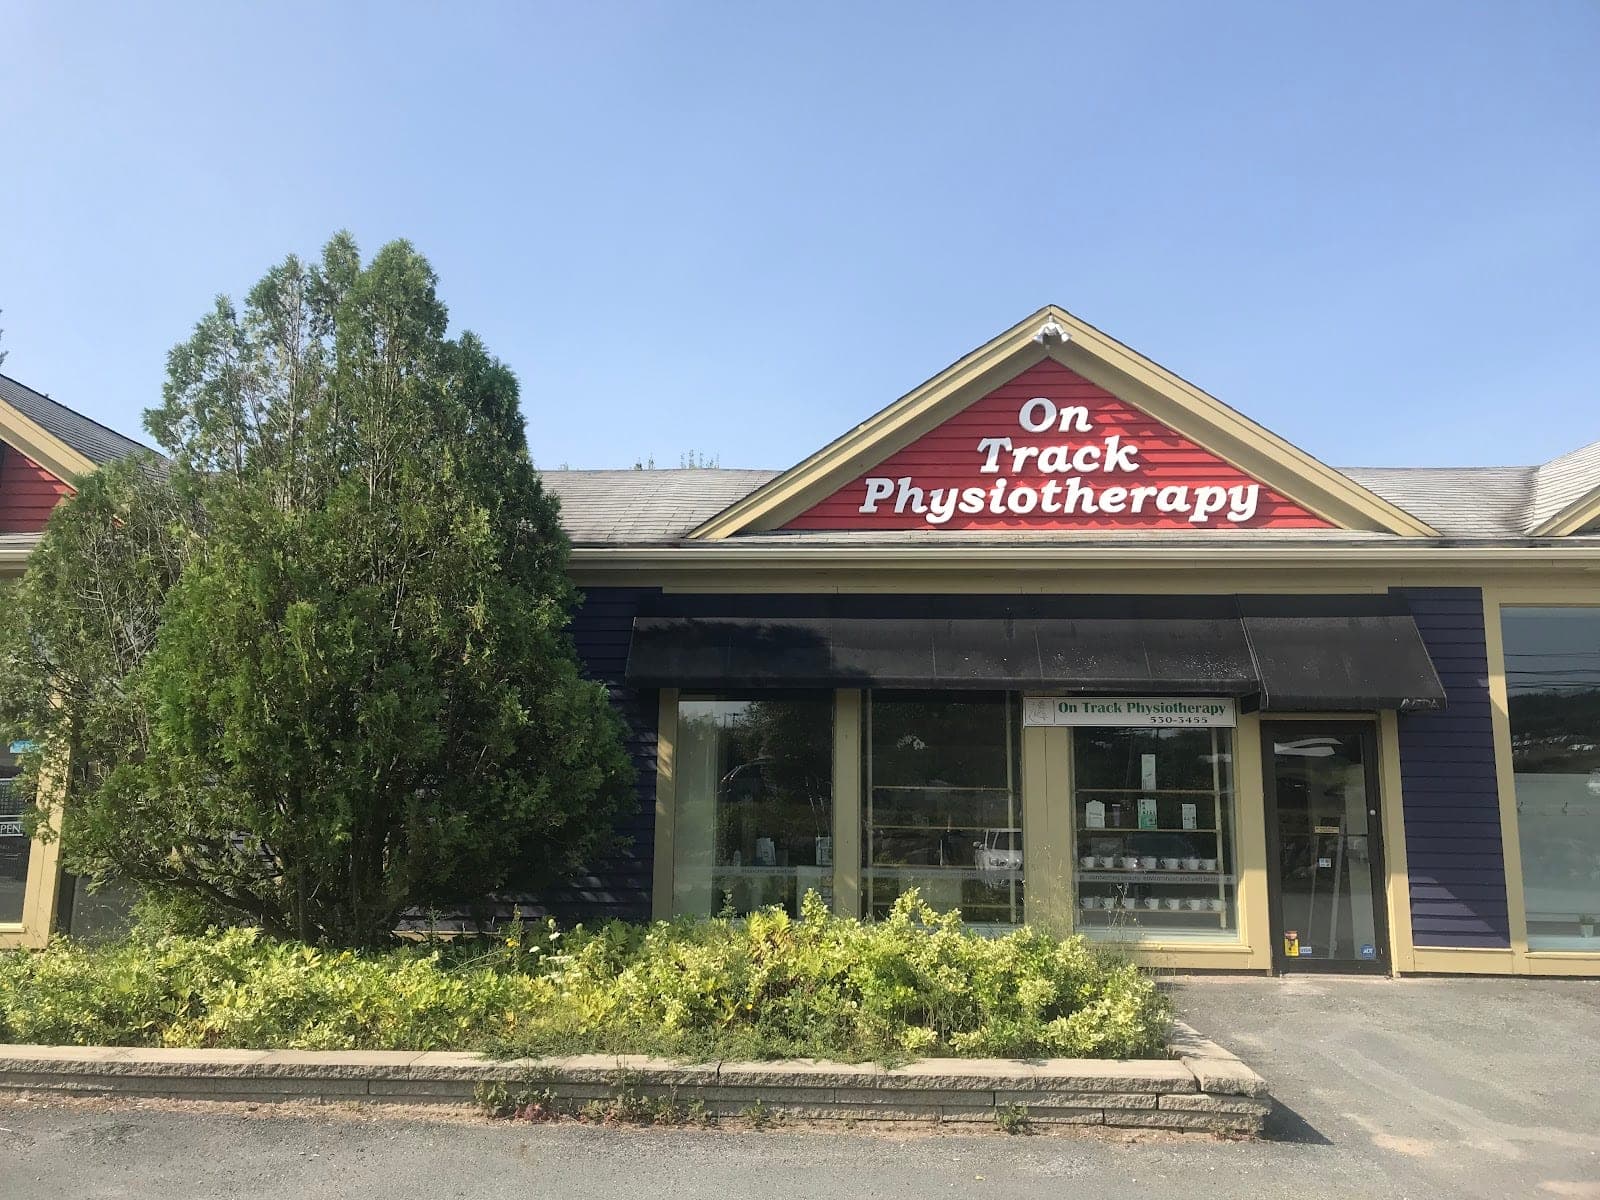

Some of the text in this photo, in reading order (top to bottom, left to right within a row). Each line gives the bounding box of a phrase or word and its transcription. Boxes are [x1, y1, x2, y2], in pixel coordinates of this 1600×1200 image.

[1018, 397, 1093, 433] On
[977, 434, 1139, 474] Track
[858, 476, 1260, 524] Physiotherapy
[1058, 701, 1226, 716] On Track Physiotherapy
[0, 824, 21, 833] PEN
